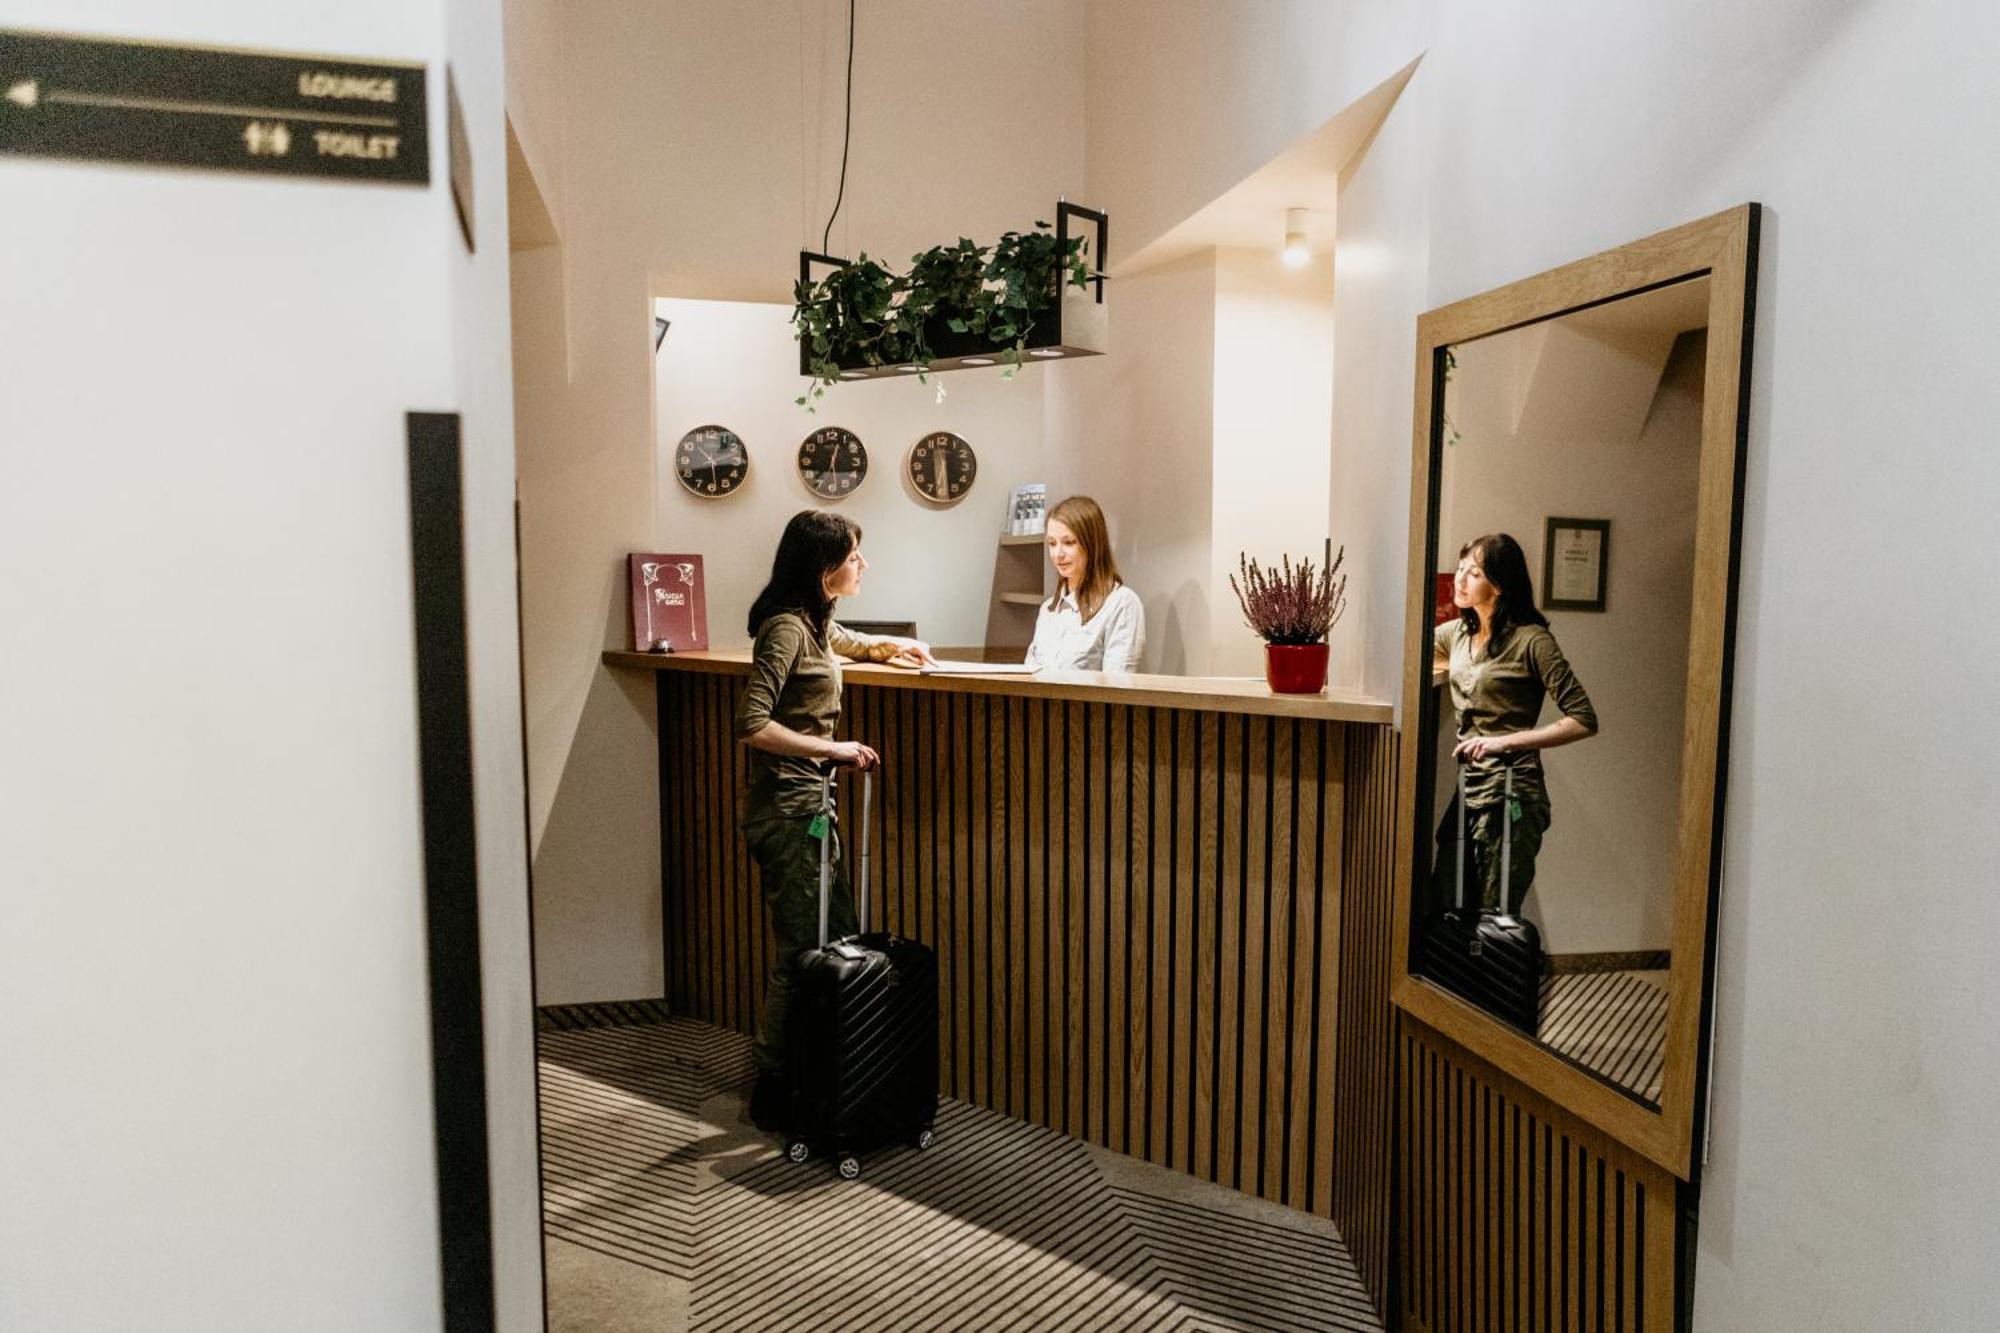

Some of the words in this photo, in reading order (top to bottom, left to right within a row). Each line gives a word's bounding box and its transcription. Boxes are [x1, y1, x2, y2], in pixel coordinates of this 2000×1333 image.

[298, 73, 397, 103] LOUNGE
[313, 131, 400, 159] TOILET
[696, 433, 703, 443] 11
[705, 430, 717, 439] 12
[816, 434, 824, 444] 11
[826, 431, 838, 440] 12
[928, 439, 935, 449] 11
[936, 436, 948, 446] 12
[684, 442, 694, 451] 10
[806, 443, 816, 452] 10
[849, 441, 858, 453] 2
[916, 448, 927, 457] 10
[959, 449, 968, 458] 2
[680, 456, 690, 465] 9
[733, 456, 741, 466] 3
[852, 457, 860, 467] 3
[912, 461, 922, 470] 9
[961, 461, 970, 472] 3
[683, 470, 693, 479] 8
[730, 469, 738, 478] 4
[916, 474, 925, 483] 8
[695, 479, 702, 489] 7
[707, 482, 717, 492] 6
[721, 479, 729, 488] 5
[816, 479, 823, 489] 7
[828, 483, 837, 492] 6
[840, 479, 849, 488] 5
[927, 483, 934, 492] 7
[950, 483, 960, 492] 5
